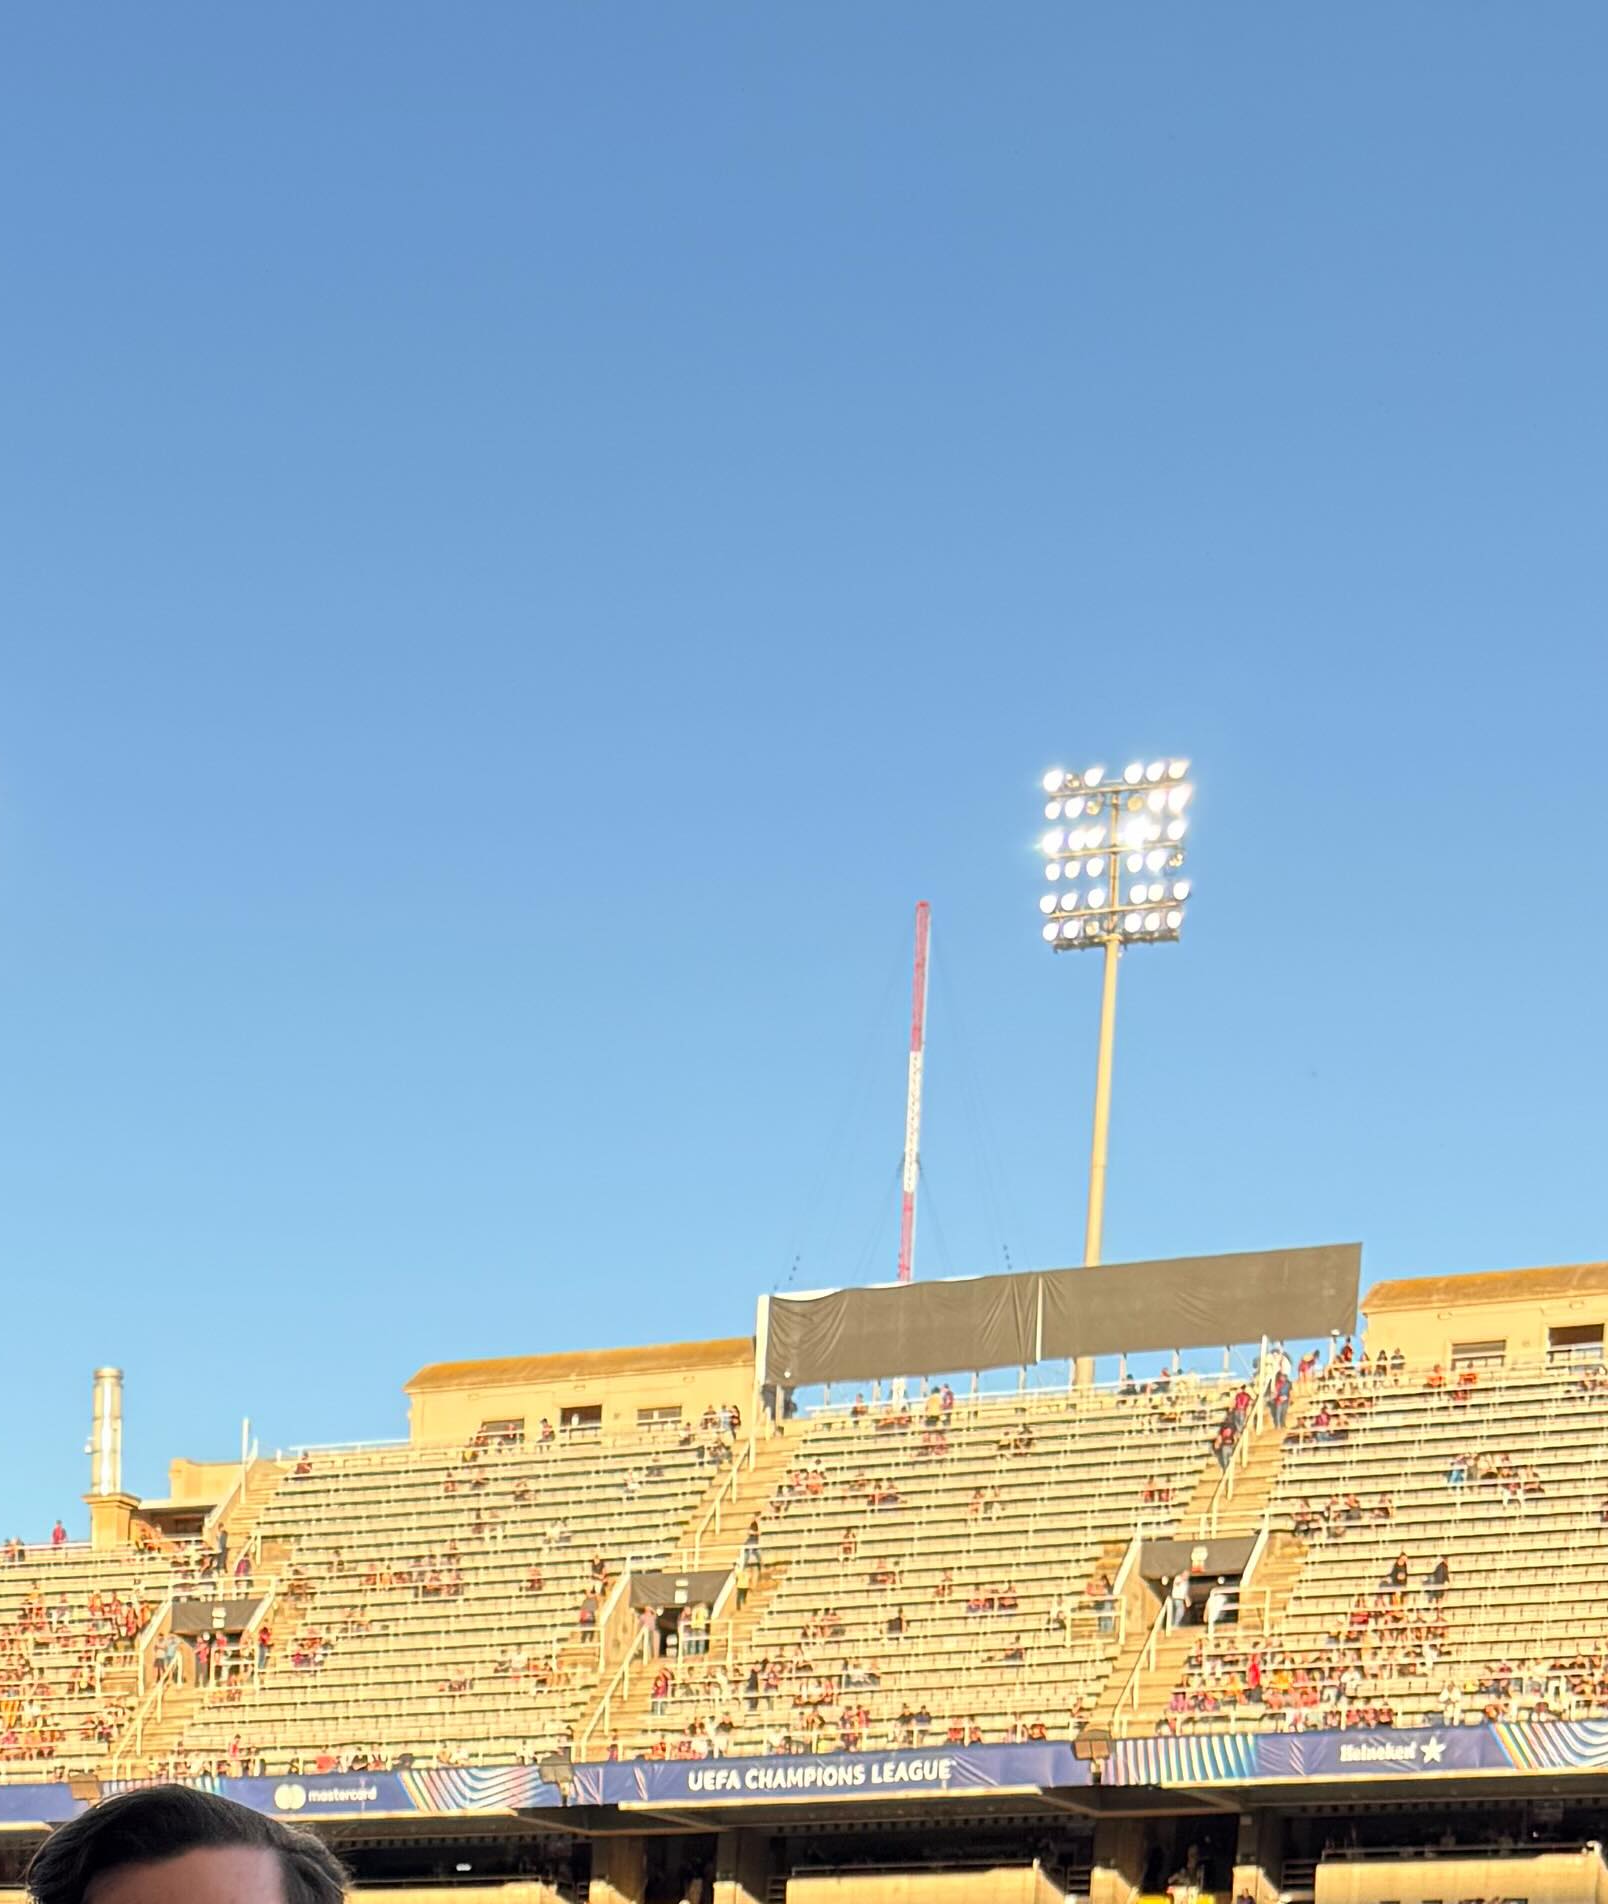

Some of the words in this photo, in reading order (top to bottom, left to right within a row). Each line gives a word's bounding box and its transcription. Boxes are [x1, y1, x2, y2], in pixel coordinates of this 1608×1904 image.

[687, 1769, 741, 1791] UEFA
[745, 1763, 865, 1789] CHAMPIONS
[871, 1759, 953, 1784] LEAGUE
[308, 1786, 377, 1802] mastercard
